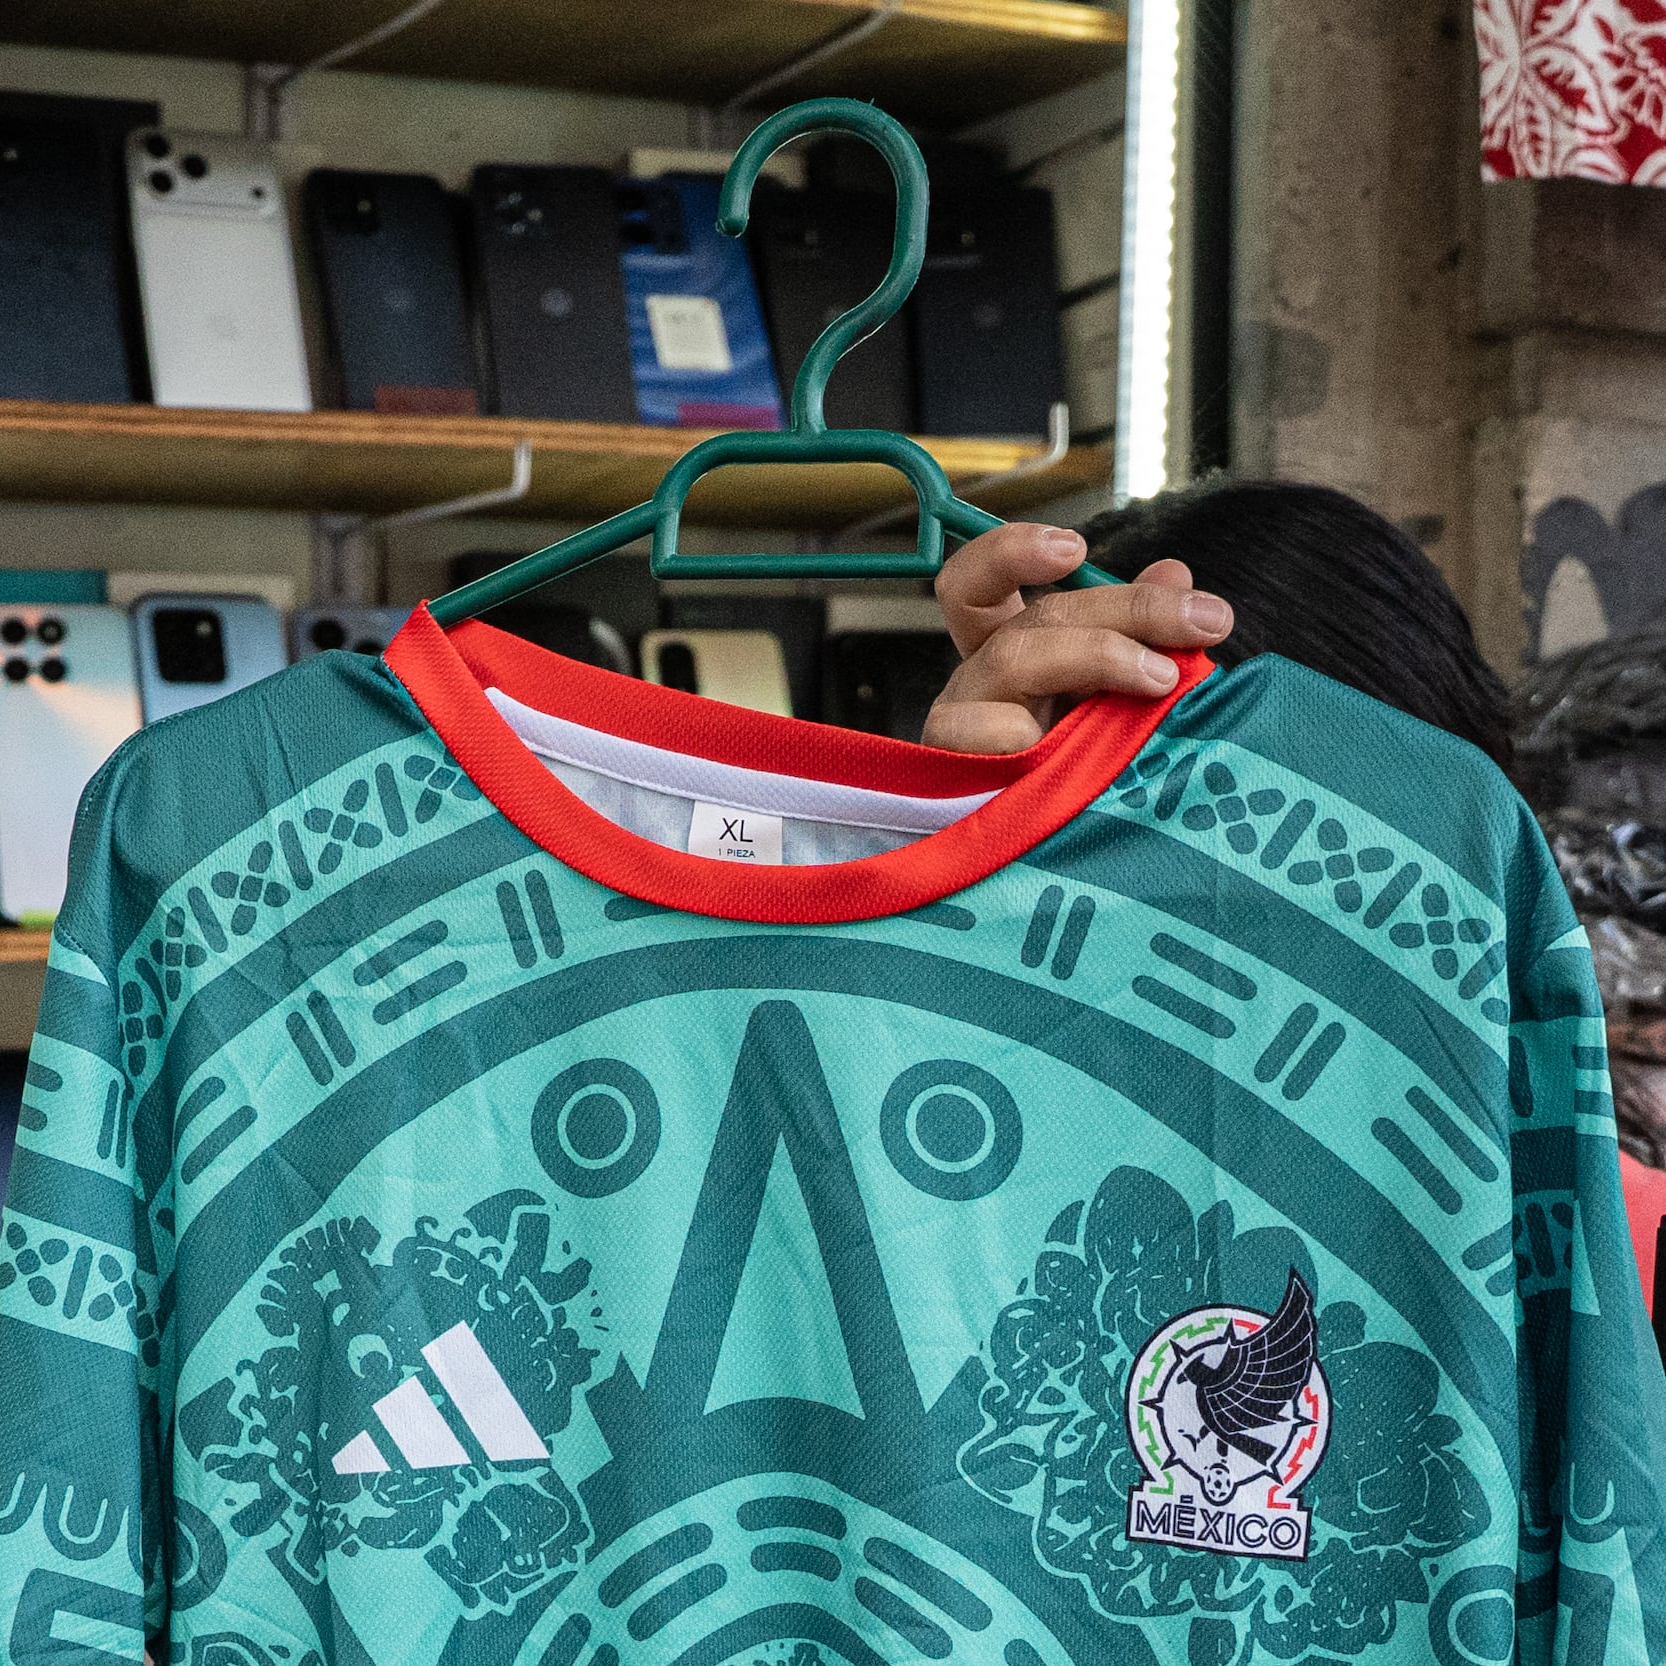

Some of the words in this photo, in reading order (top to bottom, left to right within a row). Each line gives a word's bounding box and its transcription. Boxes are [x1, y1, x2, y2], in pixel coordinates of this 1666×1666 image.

[719, 817, 753, 843] XL
[727, 848, 756, 858] PIEZA
[1135, 1495, 1302, 1551] MÉXICO
